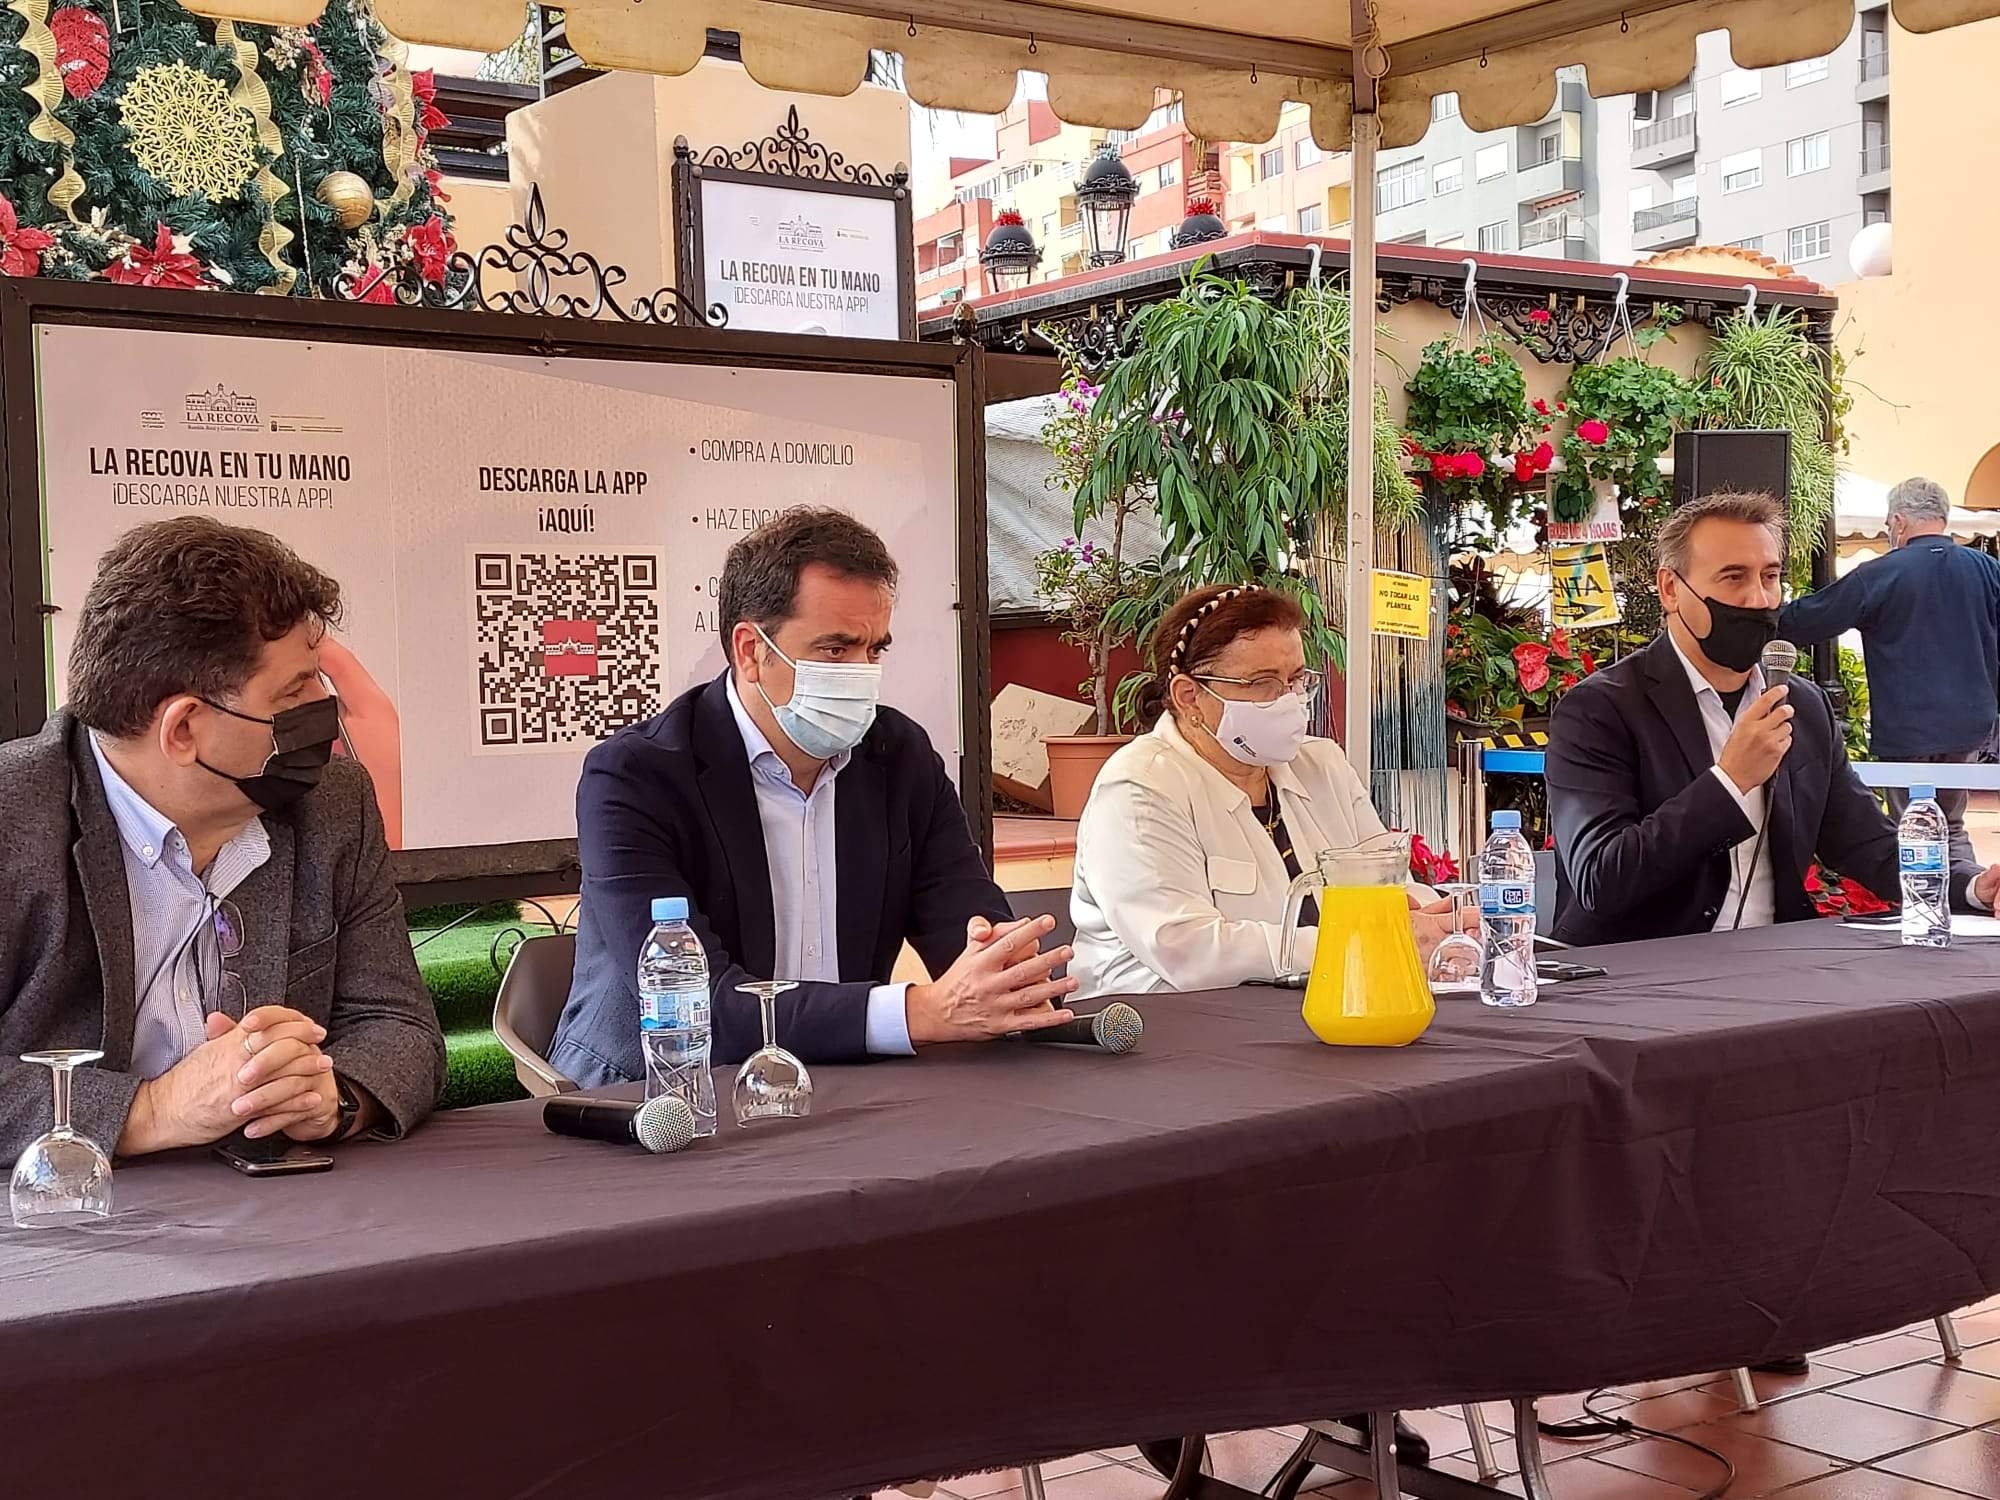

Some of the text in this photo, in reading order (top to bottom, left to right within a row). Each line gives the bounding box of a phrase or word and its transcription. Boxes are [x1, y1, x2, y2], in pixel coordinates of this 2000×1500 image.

[792, 237, 824, 248] RECOVA
[720, 260, 880, 293] LA RECOVA EN TU MANO
[734, 286, 869, 313] ¡DESCARGA NUESTRA APP!
[186, 412, 203, 422] LA
[207, 412, 260, 424] RECOVA
[90, 447, 351, 482] LA RECOVA EN TU MANO
[701, 439, 854, 466] COMPRA A DOMICILIO
[479, 466, 648, 496] DESCARGA LA APP
[112, 482, 334, 510] ¡DESCARGA NUESTRA APP!
[538, 503, 595, 533] ¡AQUÍ!
[706, 508, 738, 530] HAZ
[1588, 521, 1617, 538] HOJAS
[1390, 591, 1408, 600] TOCAR
[694, 611, 706, 632] A
